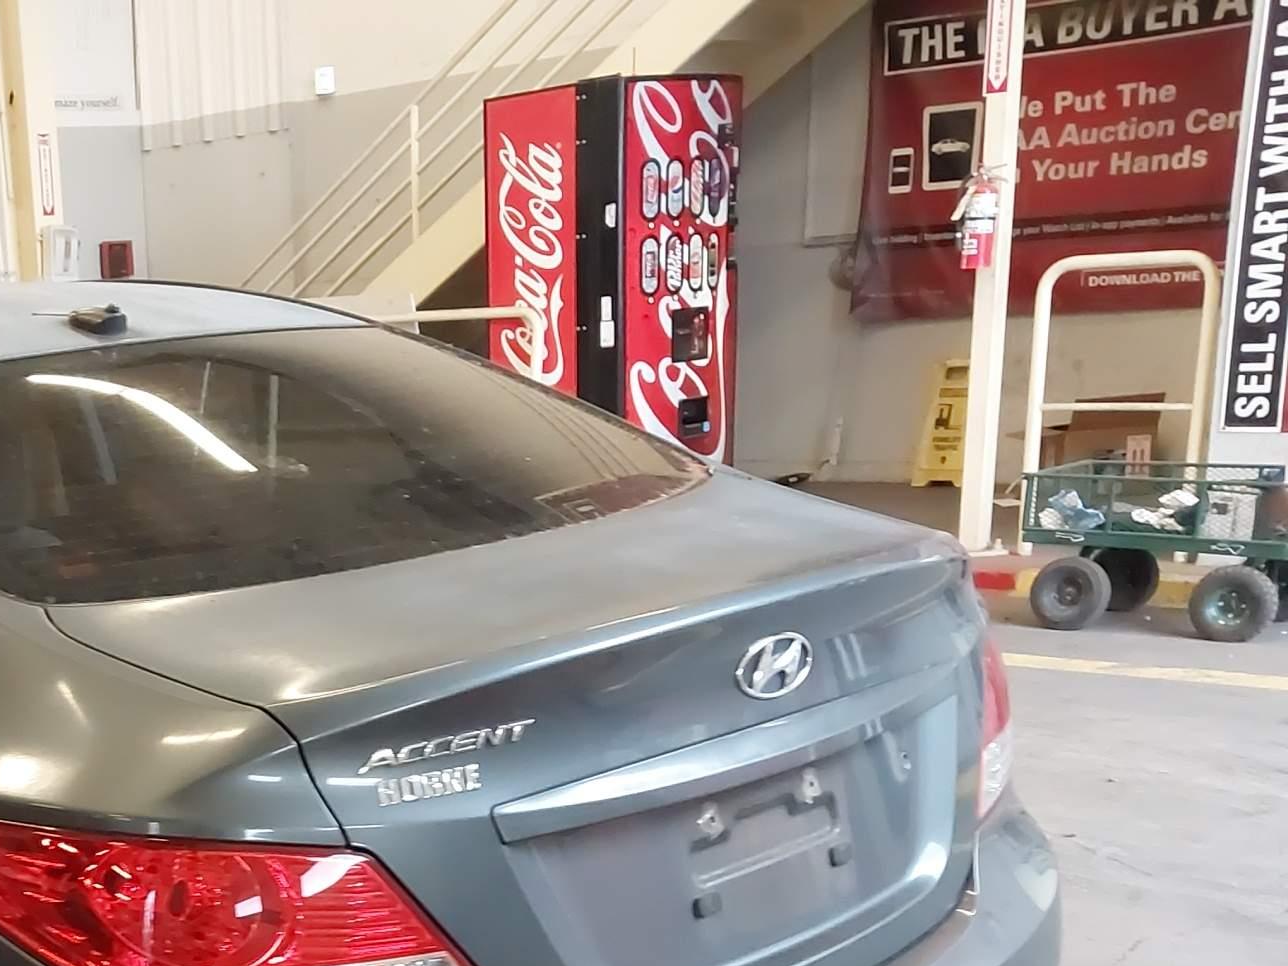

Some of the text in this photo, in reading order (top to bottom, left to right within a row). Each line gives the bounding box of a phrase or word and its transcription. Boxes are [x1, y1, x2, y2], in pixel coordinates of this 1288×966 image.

[898, 21, 966, 65] THE
[977, 12, 1045, 55] IA
[1056, 0, 1200, 45] BUYER
[1054, 89, 1107, 115] Put
[1117, 81, 1177, 108] The
[1057, 117, 1175, 148] Auction
[1185, 108, 1243, 134] Cen
[1032, 158, 1100, 182] Your
[1109, 144, 1209, 175] Hands
[1088, 270, 1201, 287] DOWNLOAD THE
[1242, 187, 1288, 324] SMART
[1234, 333, 1277, 419] SELL
[357, 718, 537, 775] ACCENT
